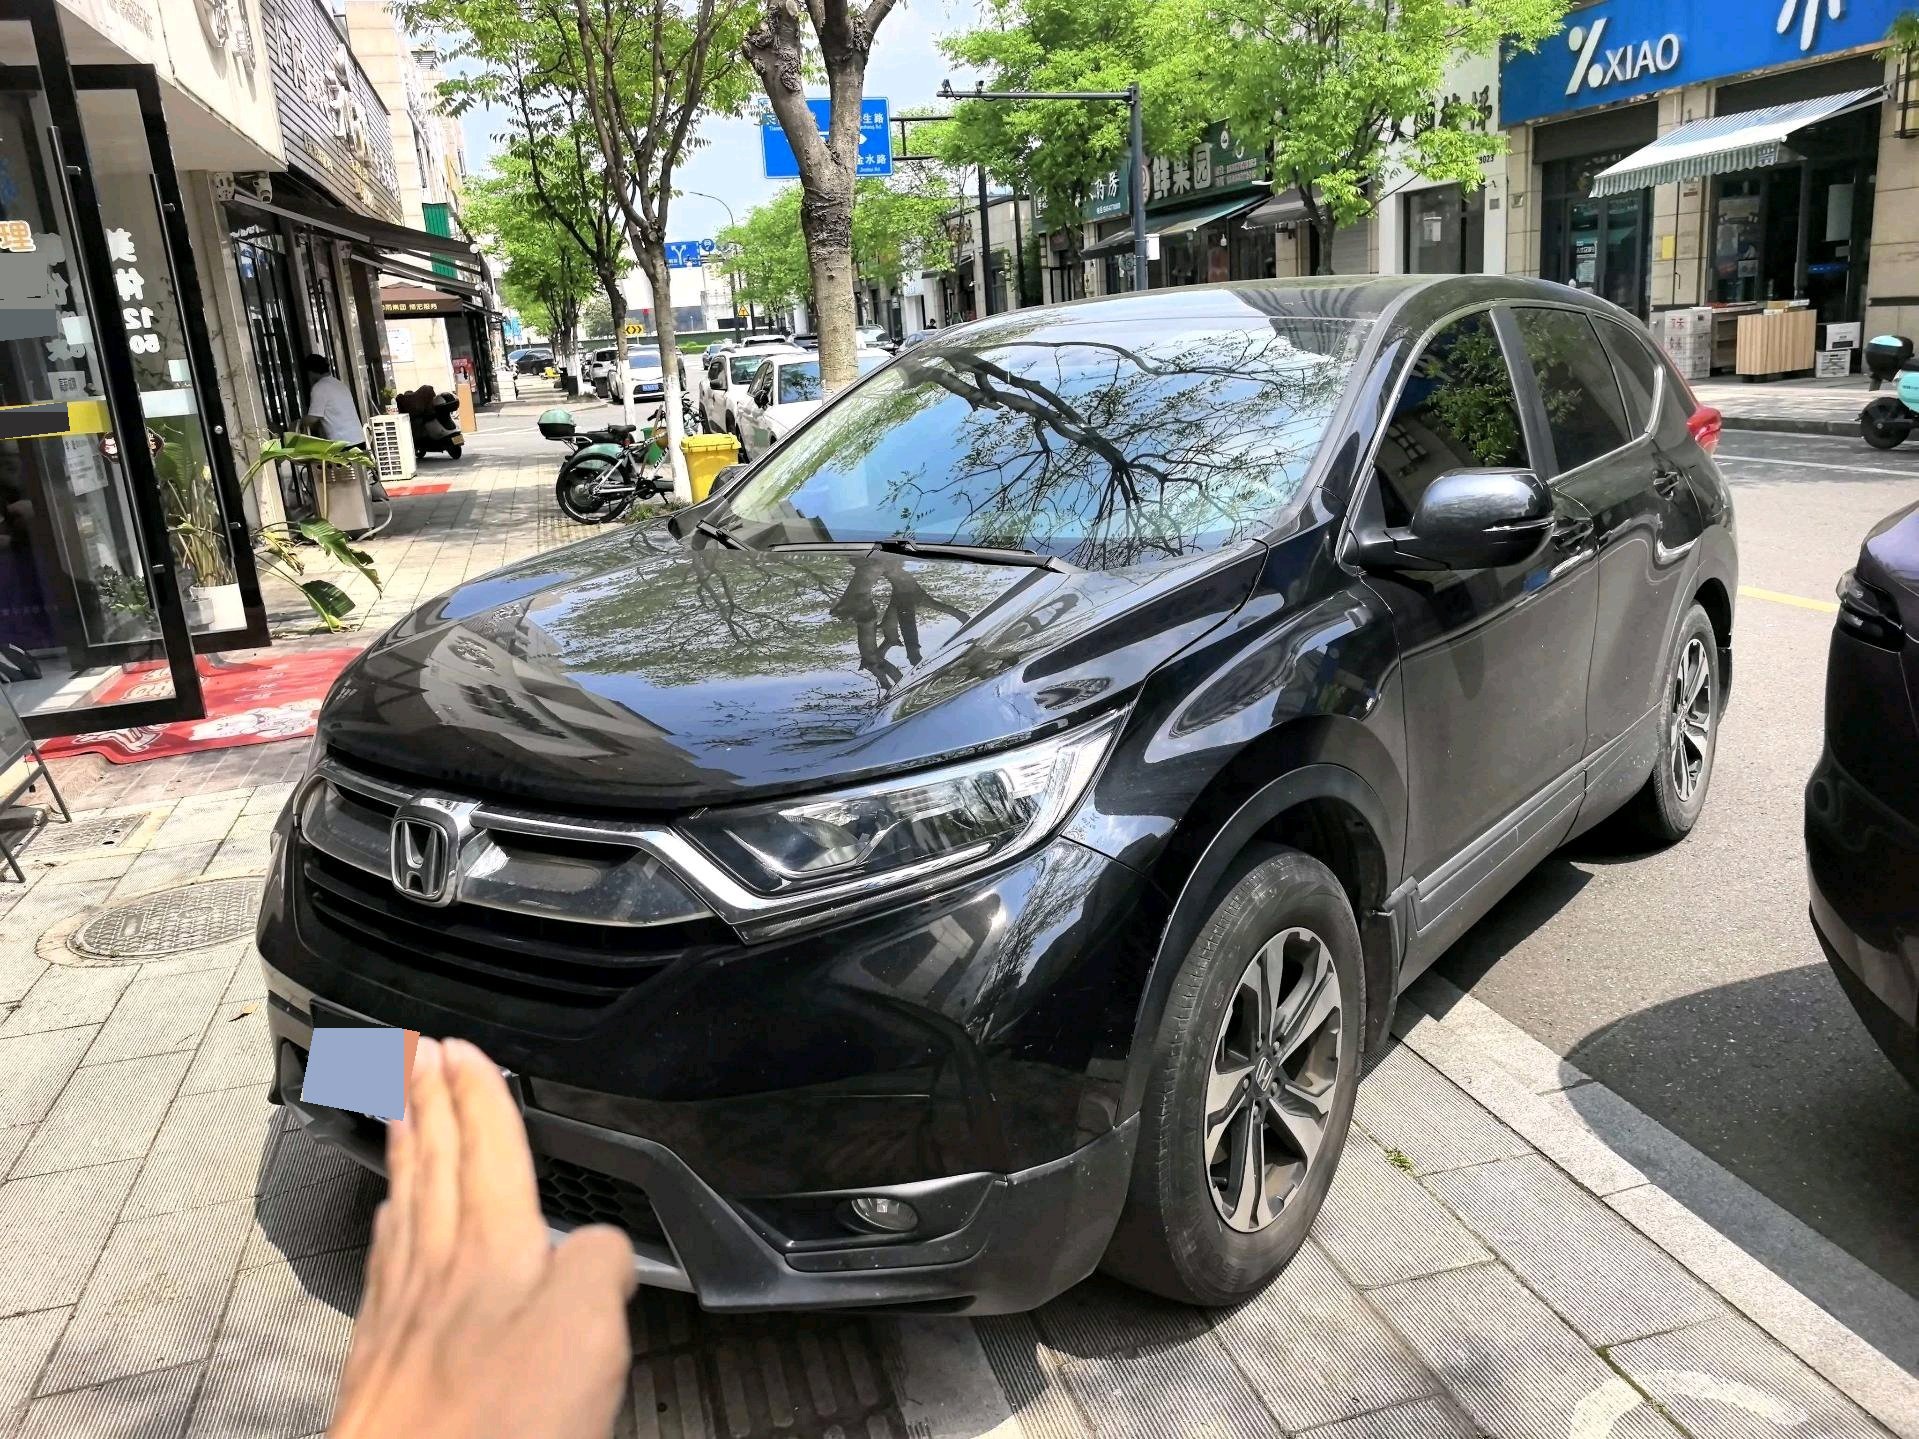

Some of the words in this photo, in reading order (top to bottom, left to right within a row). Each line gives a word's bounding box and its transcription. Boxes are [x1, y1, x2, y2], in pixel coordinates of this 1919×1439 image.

[1602, 33, 1680, 85] XIAO
[860, 113, 884, 124] 生路
[1152, 142, 1212, 199] 鲜果园
